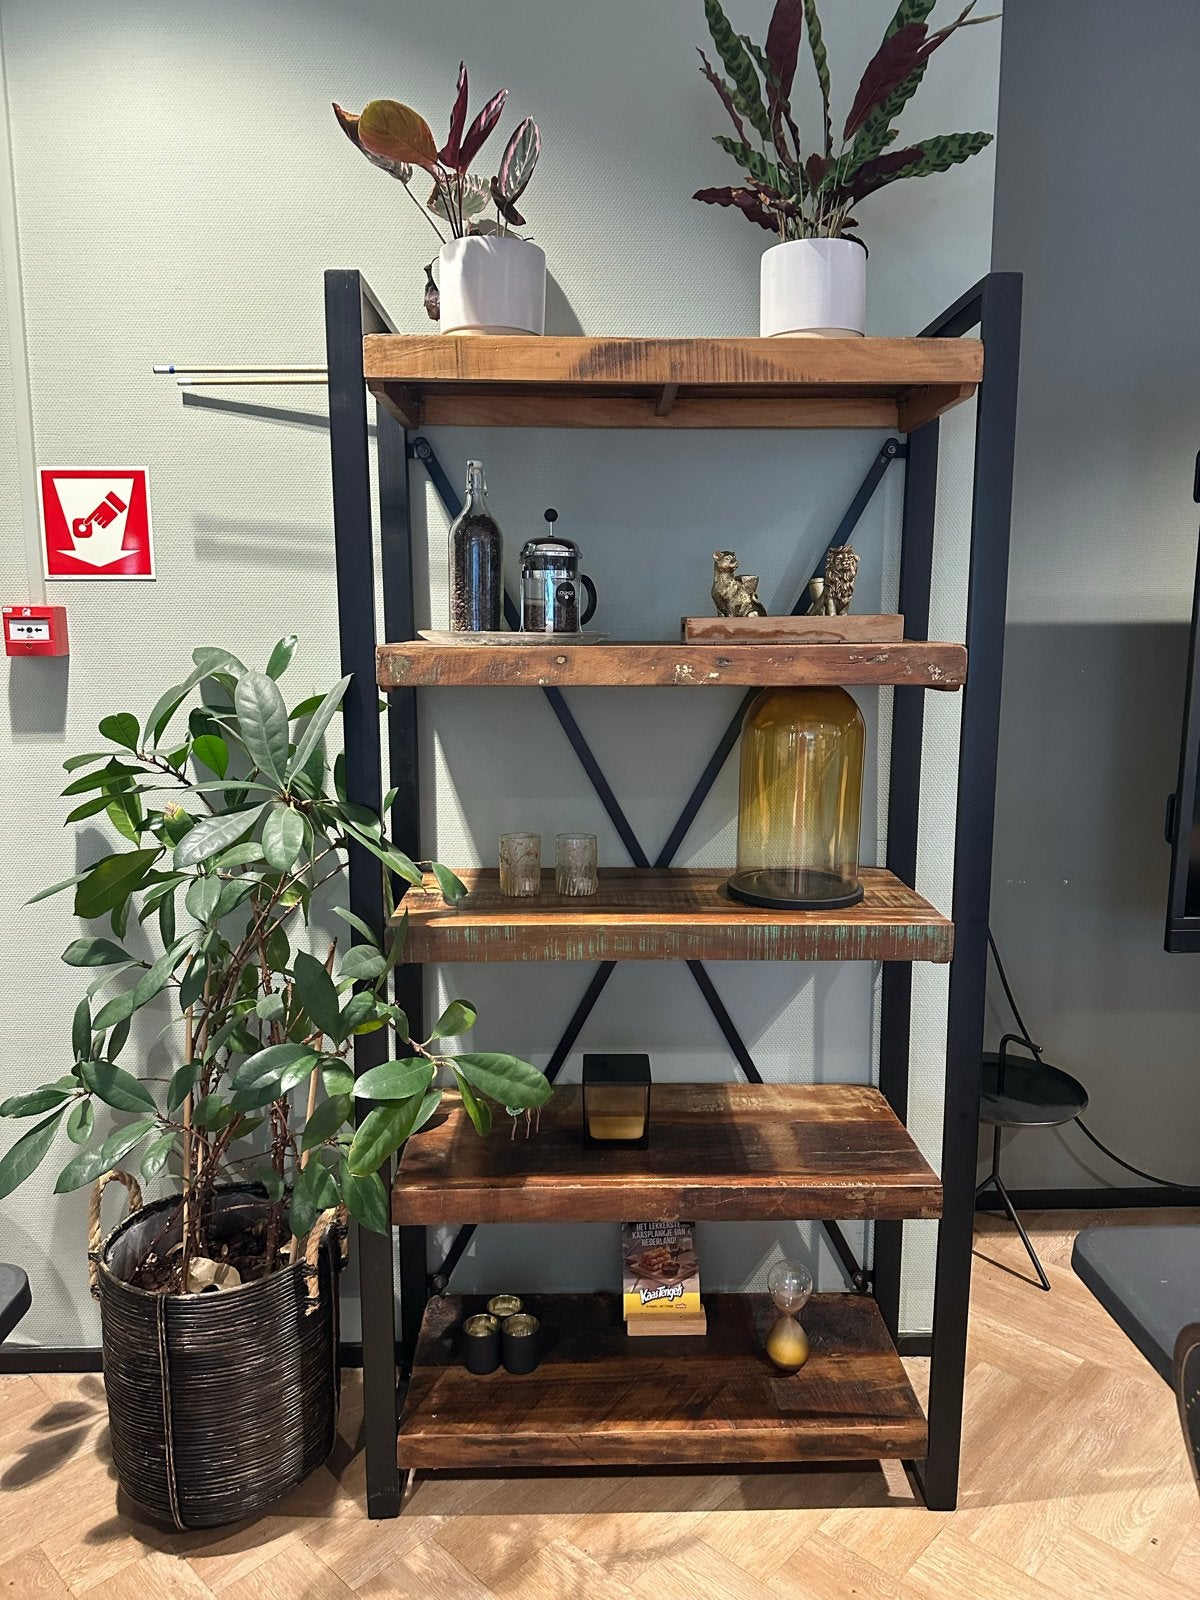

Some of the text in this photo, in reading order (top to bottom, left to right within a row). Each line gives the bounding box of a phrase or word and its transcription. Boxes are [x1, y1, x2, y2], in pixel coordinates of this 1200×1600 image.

[636, 1221, 681, 1231] HET LEKKERSTE
[632, 1228, 686, 1239] KAASPLANKJE VAN
[641, 1237, 677, 1247] NEDERLAND!
